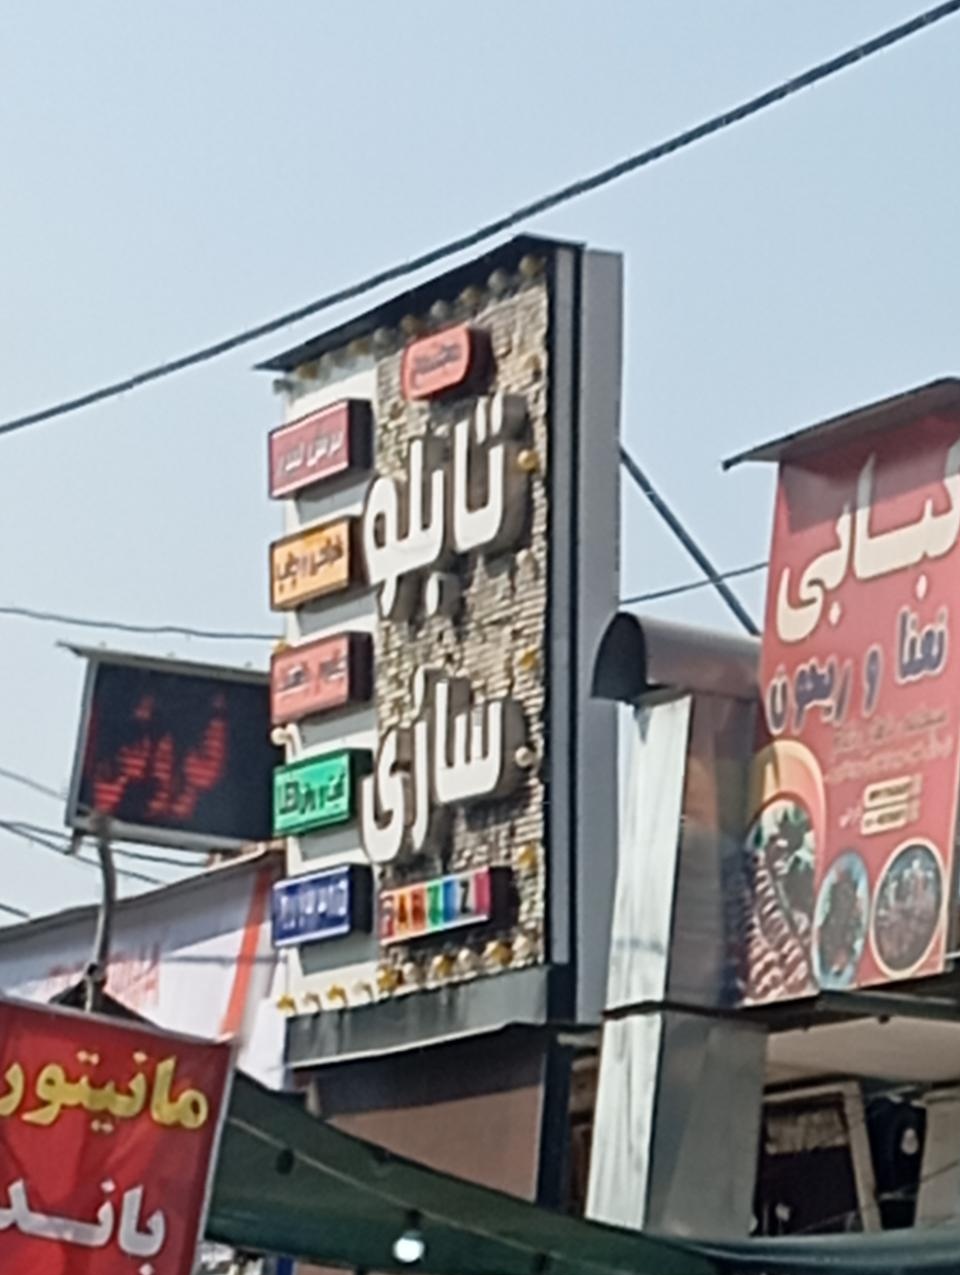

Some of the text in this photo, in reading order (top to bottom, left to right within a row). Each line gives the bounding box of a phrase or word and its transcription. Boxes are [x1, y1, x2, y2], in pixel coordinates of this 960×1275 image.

[363, 395, 505, 618] تابلو
[861, 643, 884, 717] و
[361, 665, 503, 862] سازی
[0, 1050, 209, 1133] مانیتور
